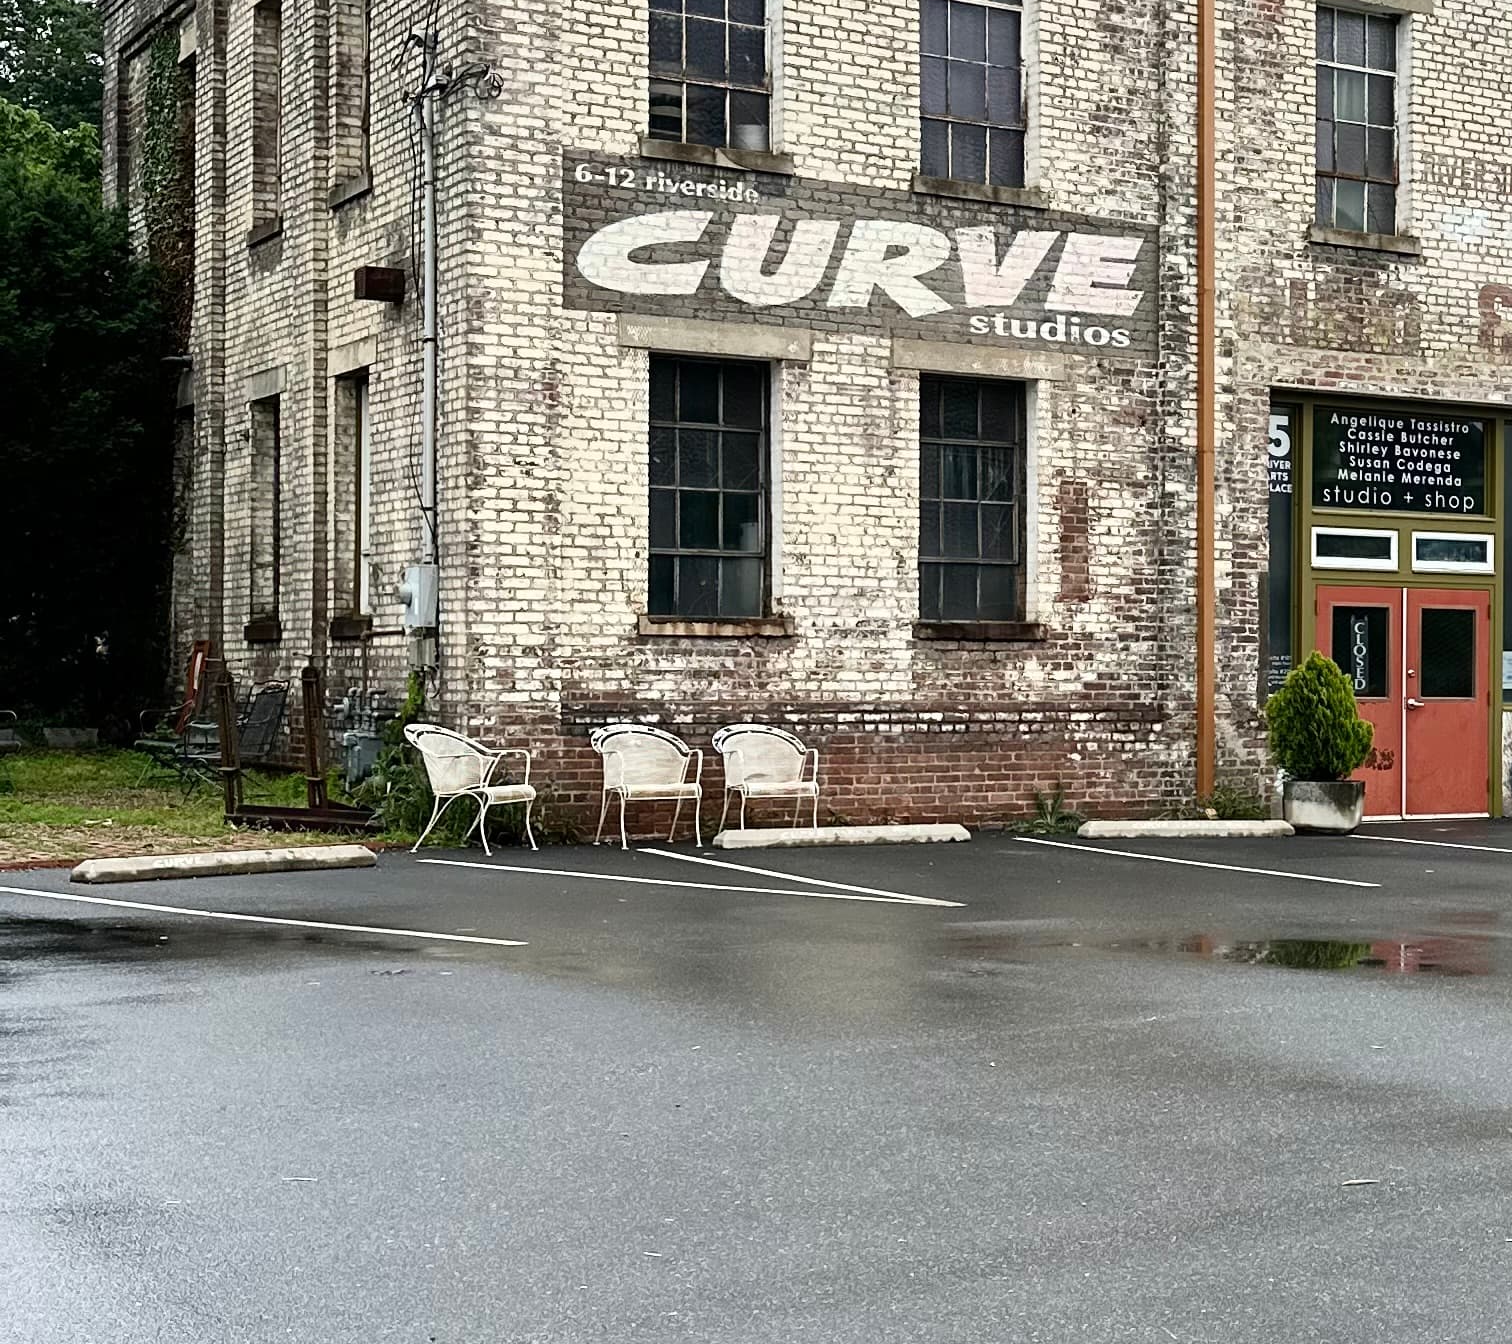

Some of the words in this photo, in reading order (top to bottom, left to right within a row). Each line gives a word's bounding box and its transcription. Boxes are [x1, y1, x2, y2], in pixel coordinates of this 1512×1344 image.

[575, 163, 636, 188] 6-12
[646, 171, 759, 204] riverside
[576, 210, 1146, 318] CURVE
[969, 311, 1131, 348] studios
[1331, 413, 1404, 430] Angelique
[1410, 419, 1469, 434] Tassistro
[1348, 428, 1394, 442] Cassie
[1401, 432, 1454, 446] Butcher
[1339, 441, 1388, 457] Shirley
[1395, 445, 1461, 460] Bavonese
[1349, 456, 1390, 469] Susan
[1397, 459, 1450, 475] Codega
[1269, 482, 1293, 493] LACE
[1338, 469, 1395, 483] Melanie
[1401, 472, 1462, 487] Merenda
[1323, 485, 1392, 505] studio
[1404, 492, 1413, 503] +
[1425, 490, 1474, 513] shop
[1353, 622, 1367, 690] CLOSED
